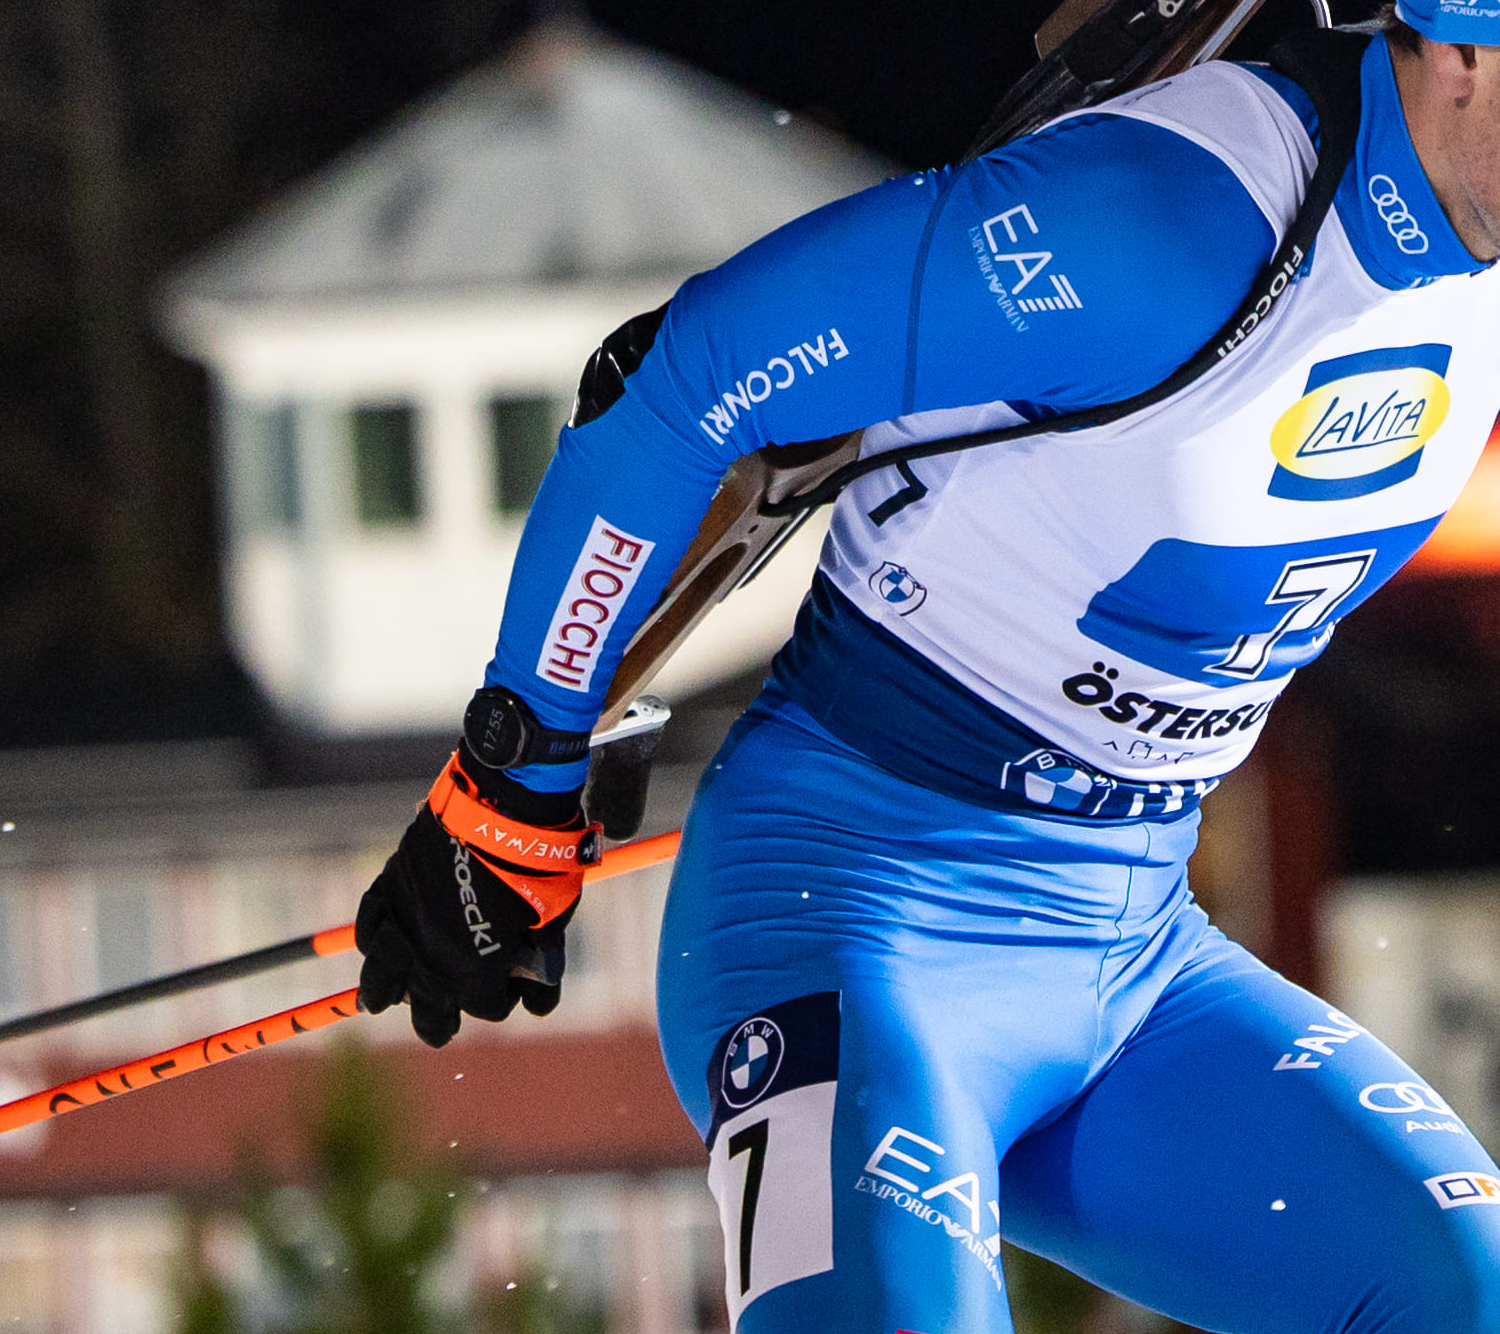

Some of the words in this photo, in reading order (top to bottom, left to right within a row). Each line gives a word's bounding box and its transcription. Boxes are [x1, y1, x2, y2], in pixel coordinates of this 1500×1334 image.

[982, 203, 1084, 313] EA7
[1217, 244, 1305, 358] FIOCCHI
[545, 528, 643, 688] FIOCCHI
[1204, 548, 1378, 680] 7
[728, 1023, 775, 1058] BMW
[728, 1118, 769, 1297] 7
[854, 1175, 943, 1226] EMPORIO
